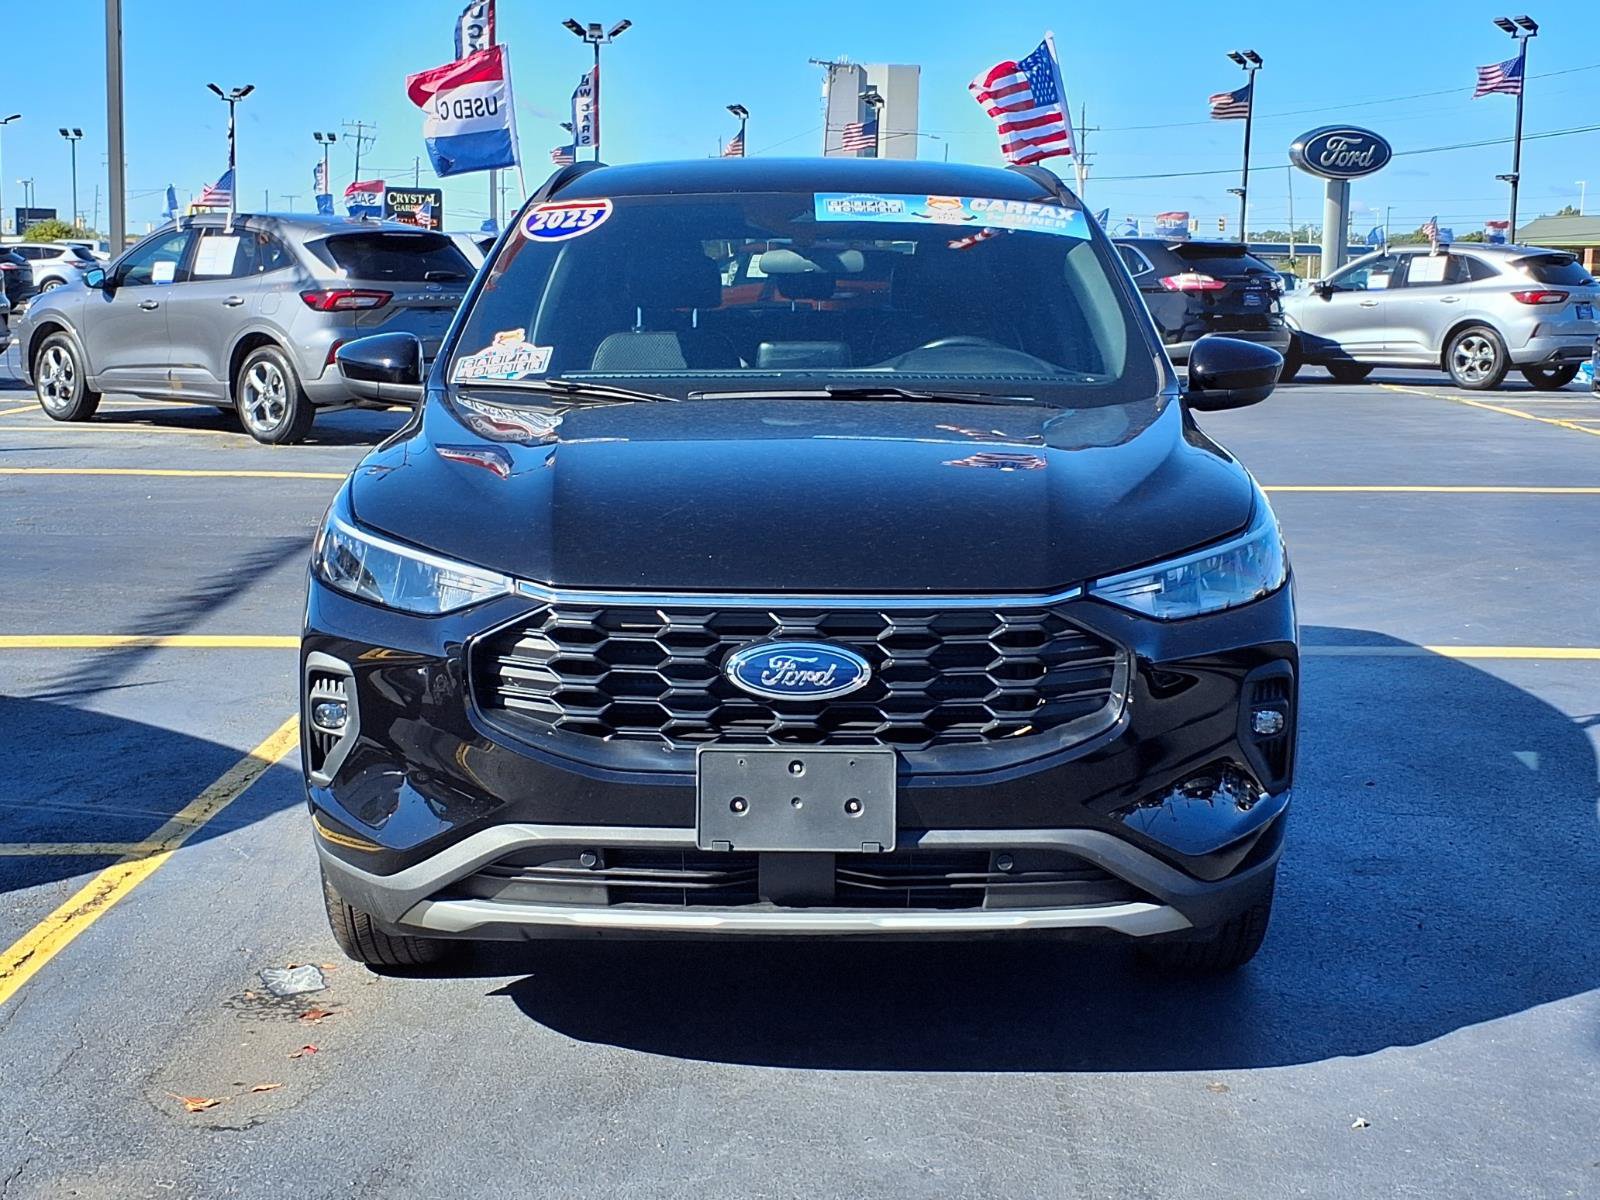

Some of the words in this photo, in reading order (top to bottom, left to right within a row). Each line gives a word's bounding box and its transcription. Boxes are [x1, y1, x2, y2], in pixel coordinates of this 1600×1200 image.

[1320, 136, 1376, 167] Ford
[387, 191, 440, 207] CRYSTAL
[969, 199, 1075, 221] CARFAX
[528, 209, 598, 231] 2025
[761, 655, 837, 687] Ford
